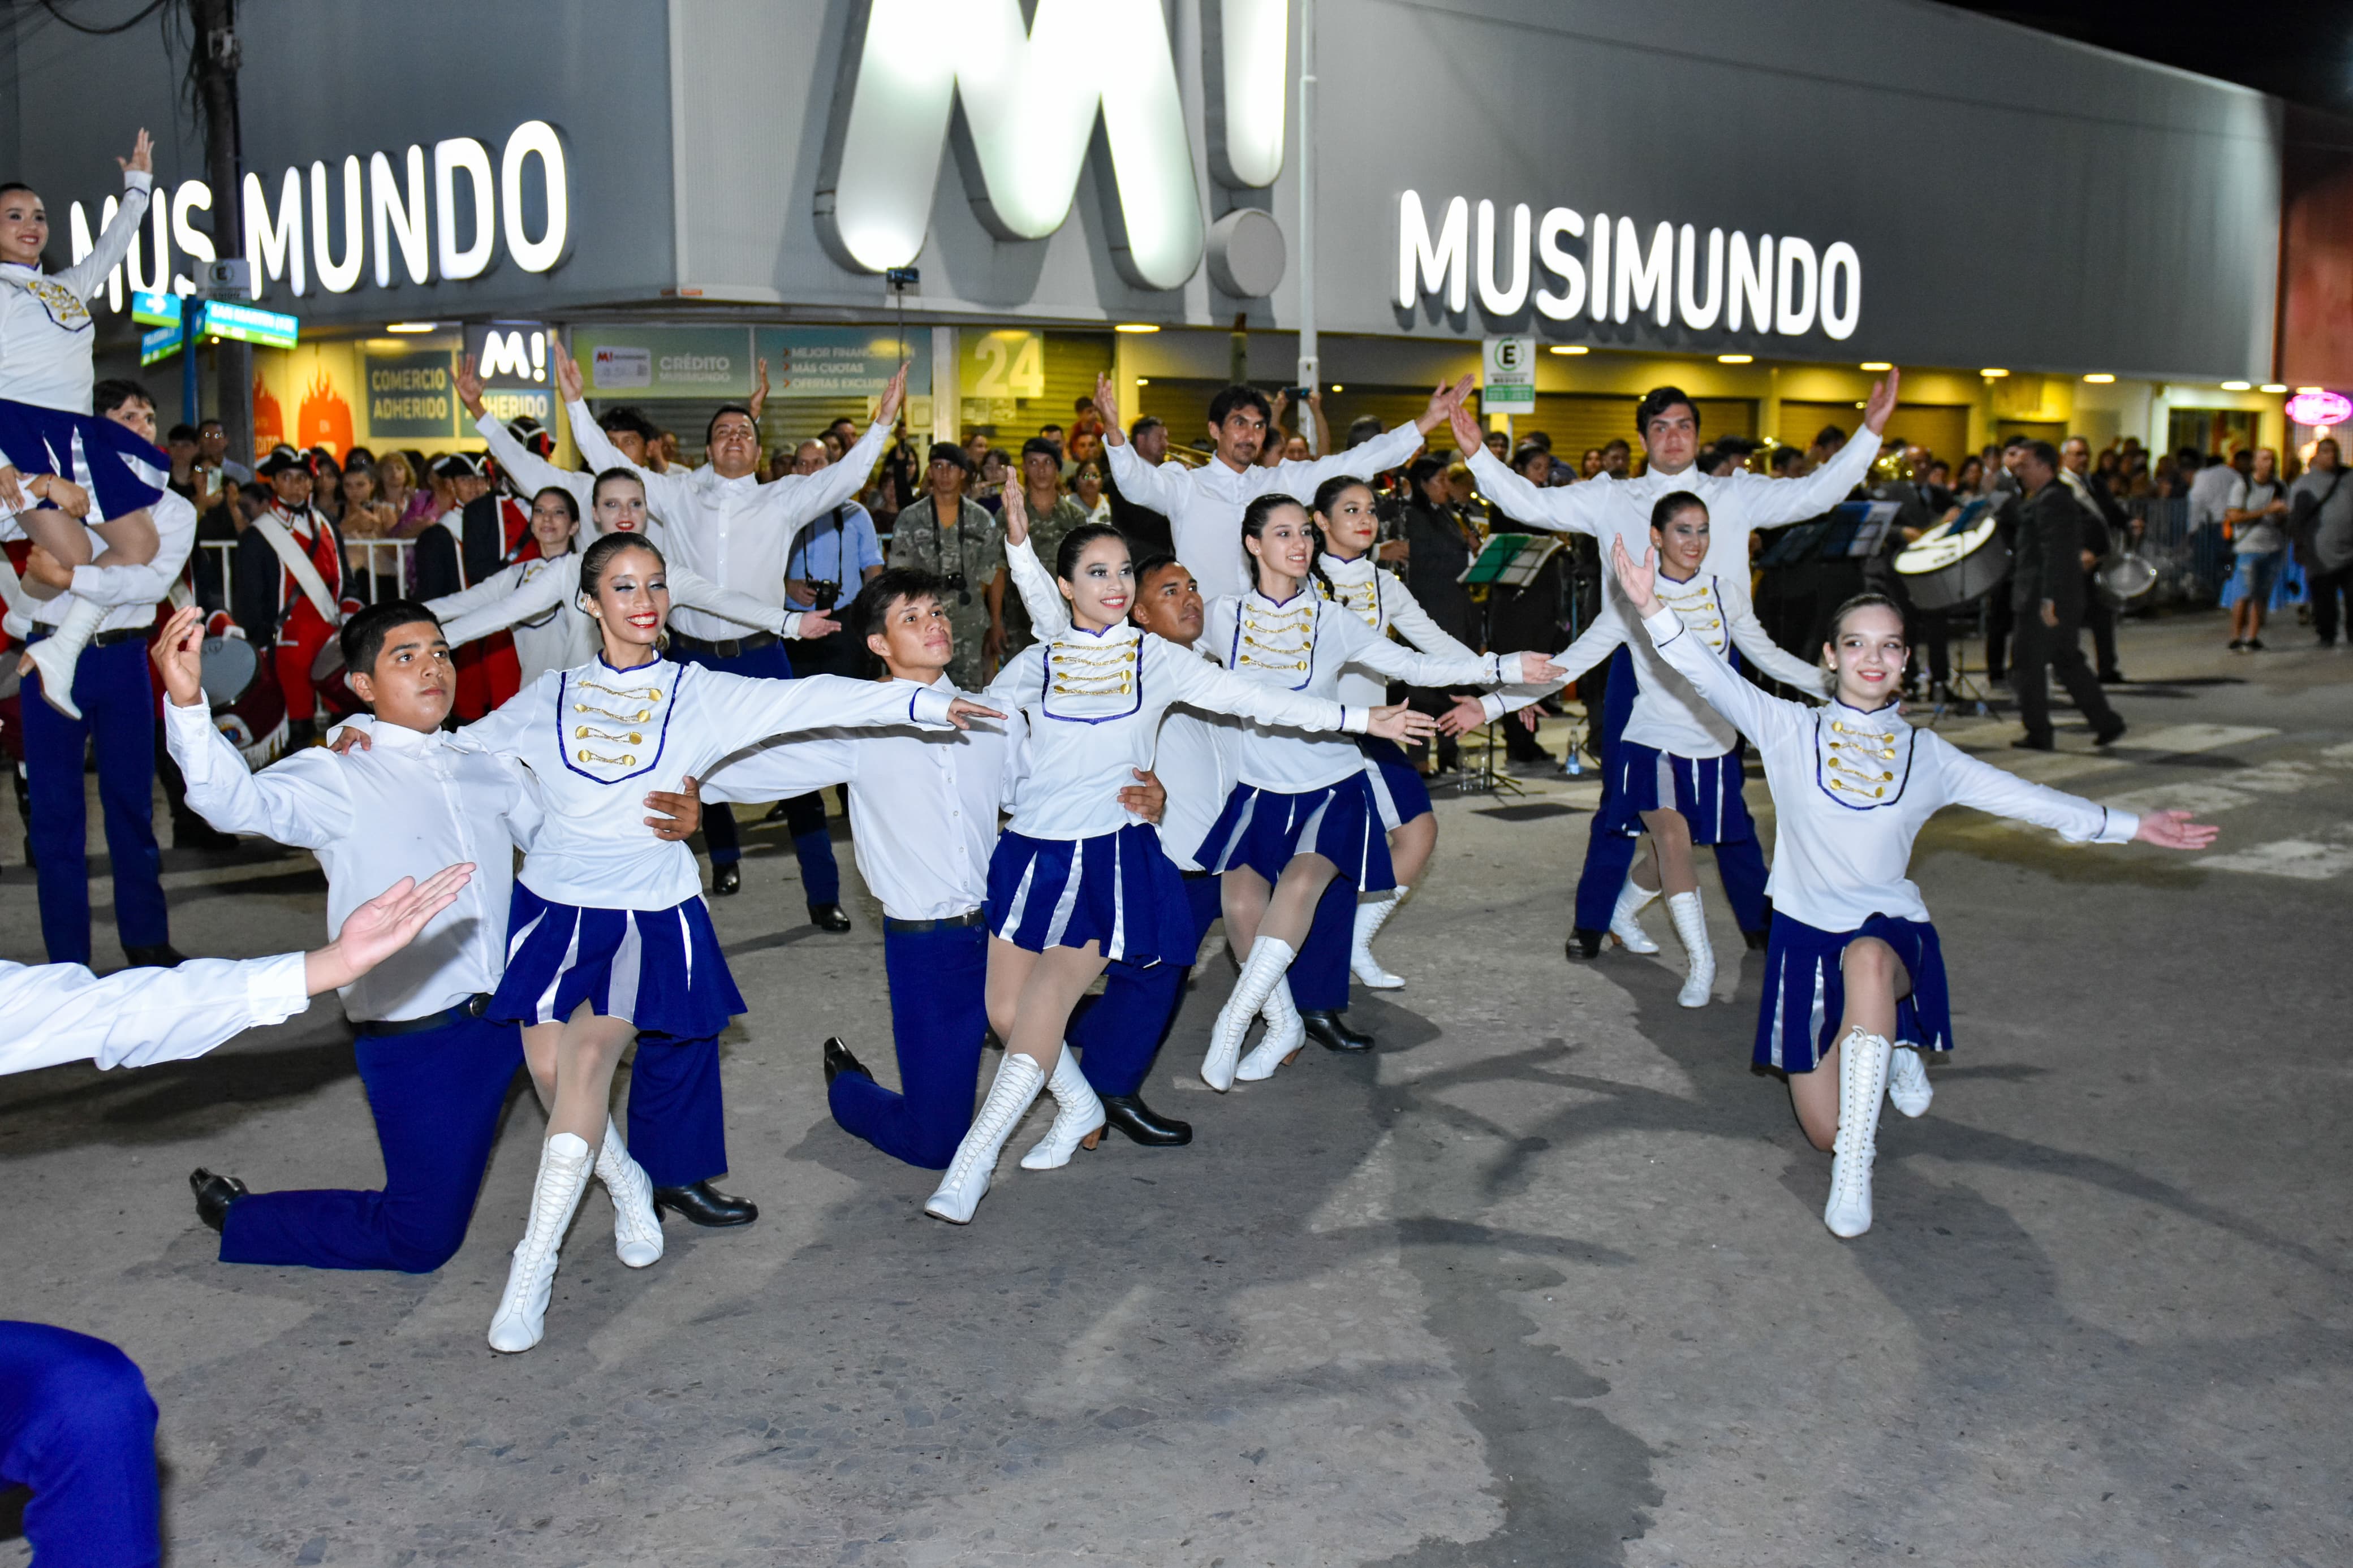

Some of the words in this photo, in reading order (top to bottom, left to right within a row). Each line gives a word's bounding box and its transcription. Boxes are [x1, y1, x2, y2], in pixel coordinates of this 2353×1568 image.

[70, 120, 567, 313] MUSMUNDO
[1399, 189, 1861, 340] MUSIMUNDO
[480, 331, 546, 382] M!
[660, 352, 730, 371] CRÉDITO
[792, 347, 830, 358] MEJOR
[1503, 345, 1516, 364] E
[792, 362, 816, 373] MÁS
[819, 363, 864, 373] CUOTAS
[975, 332, 1044, 398] 24
[372, 368, 447, 391] COMERCIO
[792, 377, 839, 388] OFERTAS
[373, 396, 447, 420] ADHERIDO
